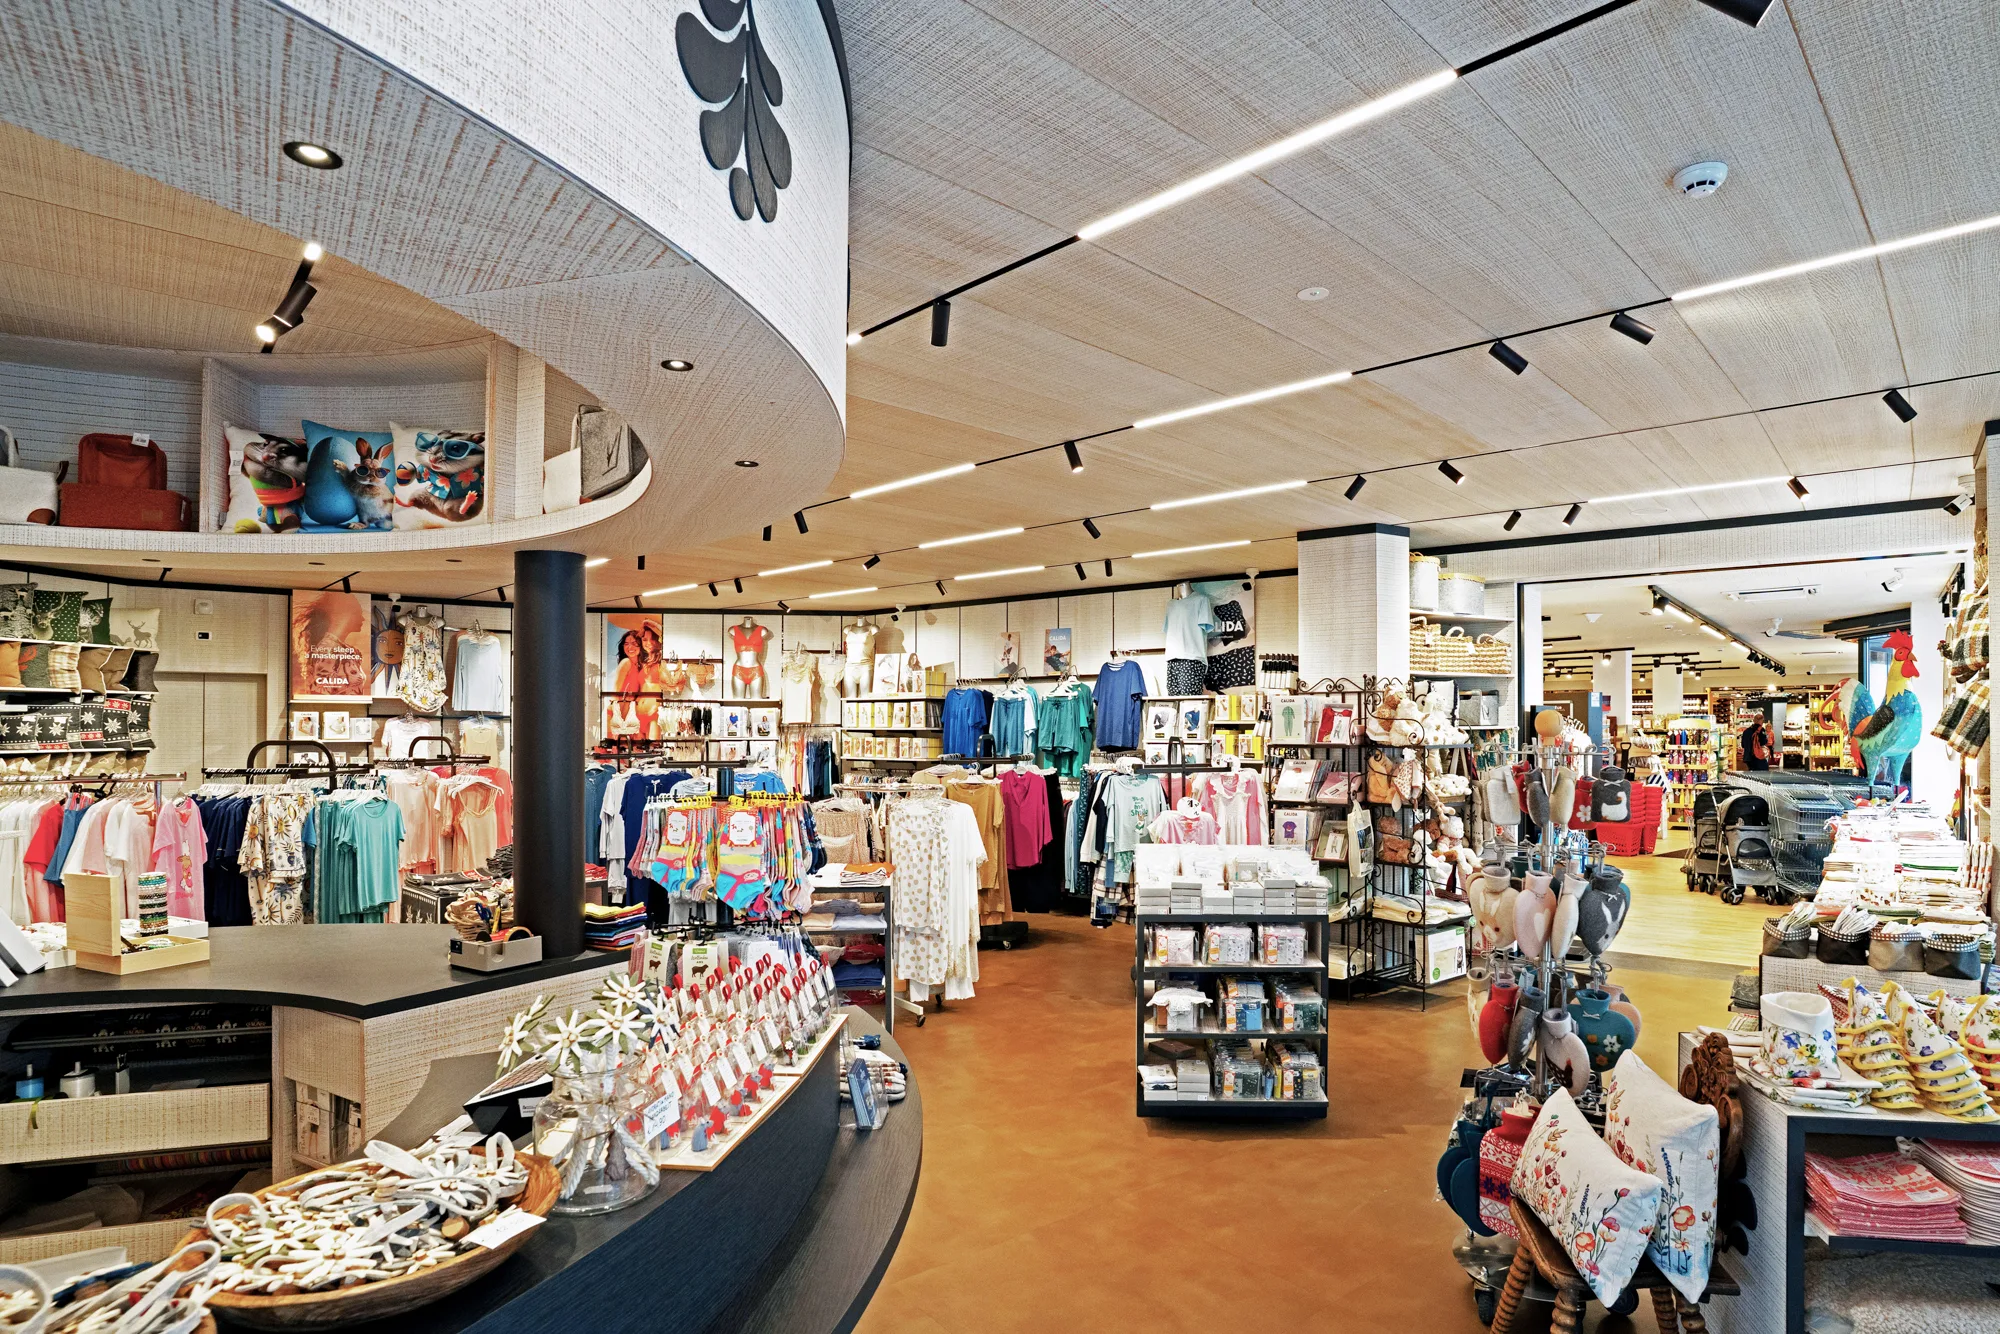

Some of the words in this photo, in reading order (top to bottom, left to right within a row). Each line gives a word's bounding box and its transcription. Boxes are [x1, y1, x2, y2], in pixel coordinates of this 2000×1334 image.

[1214, 620, 1244, 632] LIDA
[310, 645, 332, 653] Every
[333, 645, 355, 654] sleep
